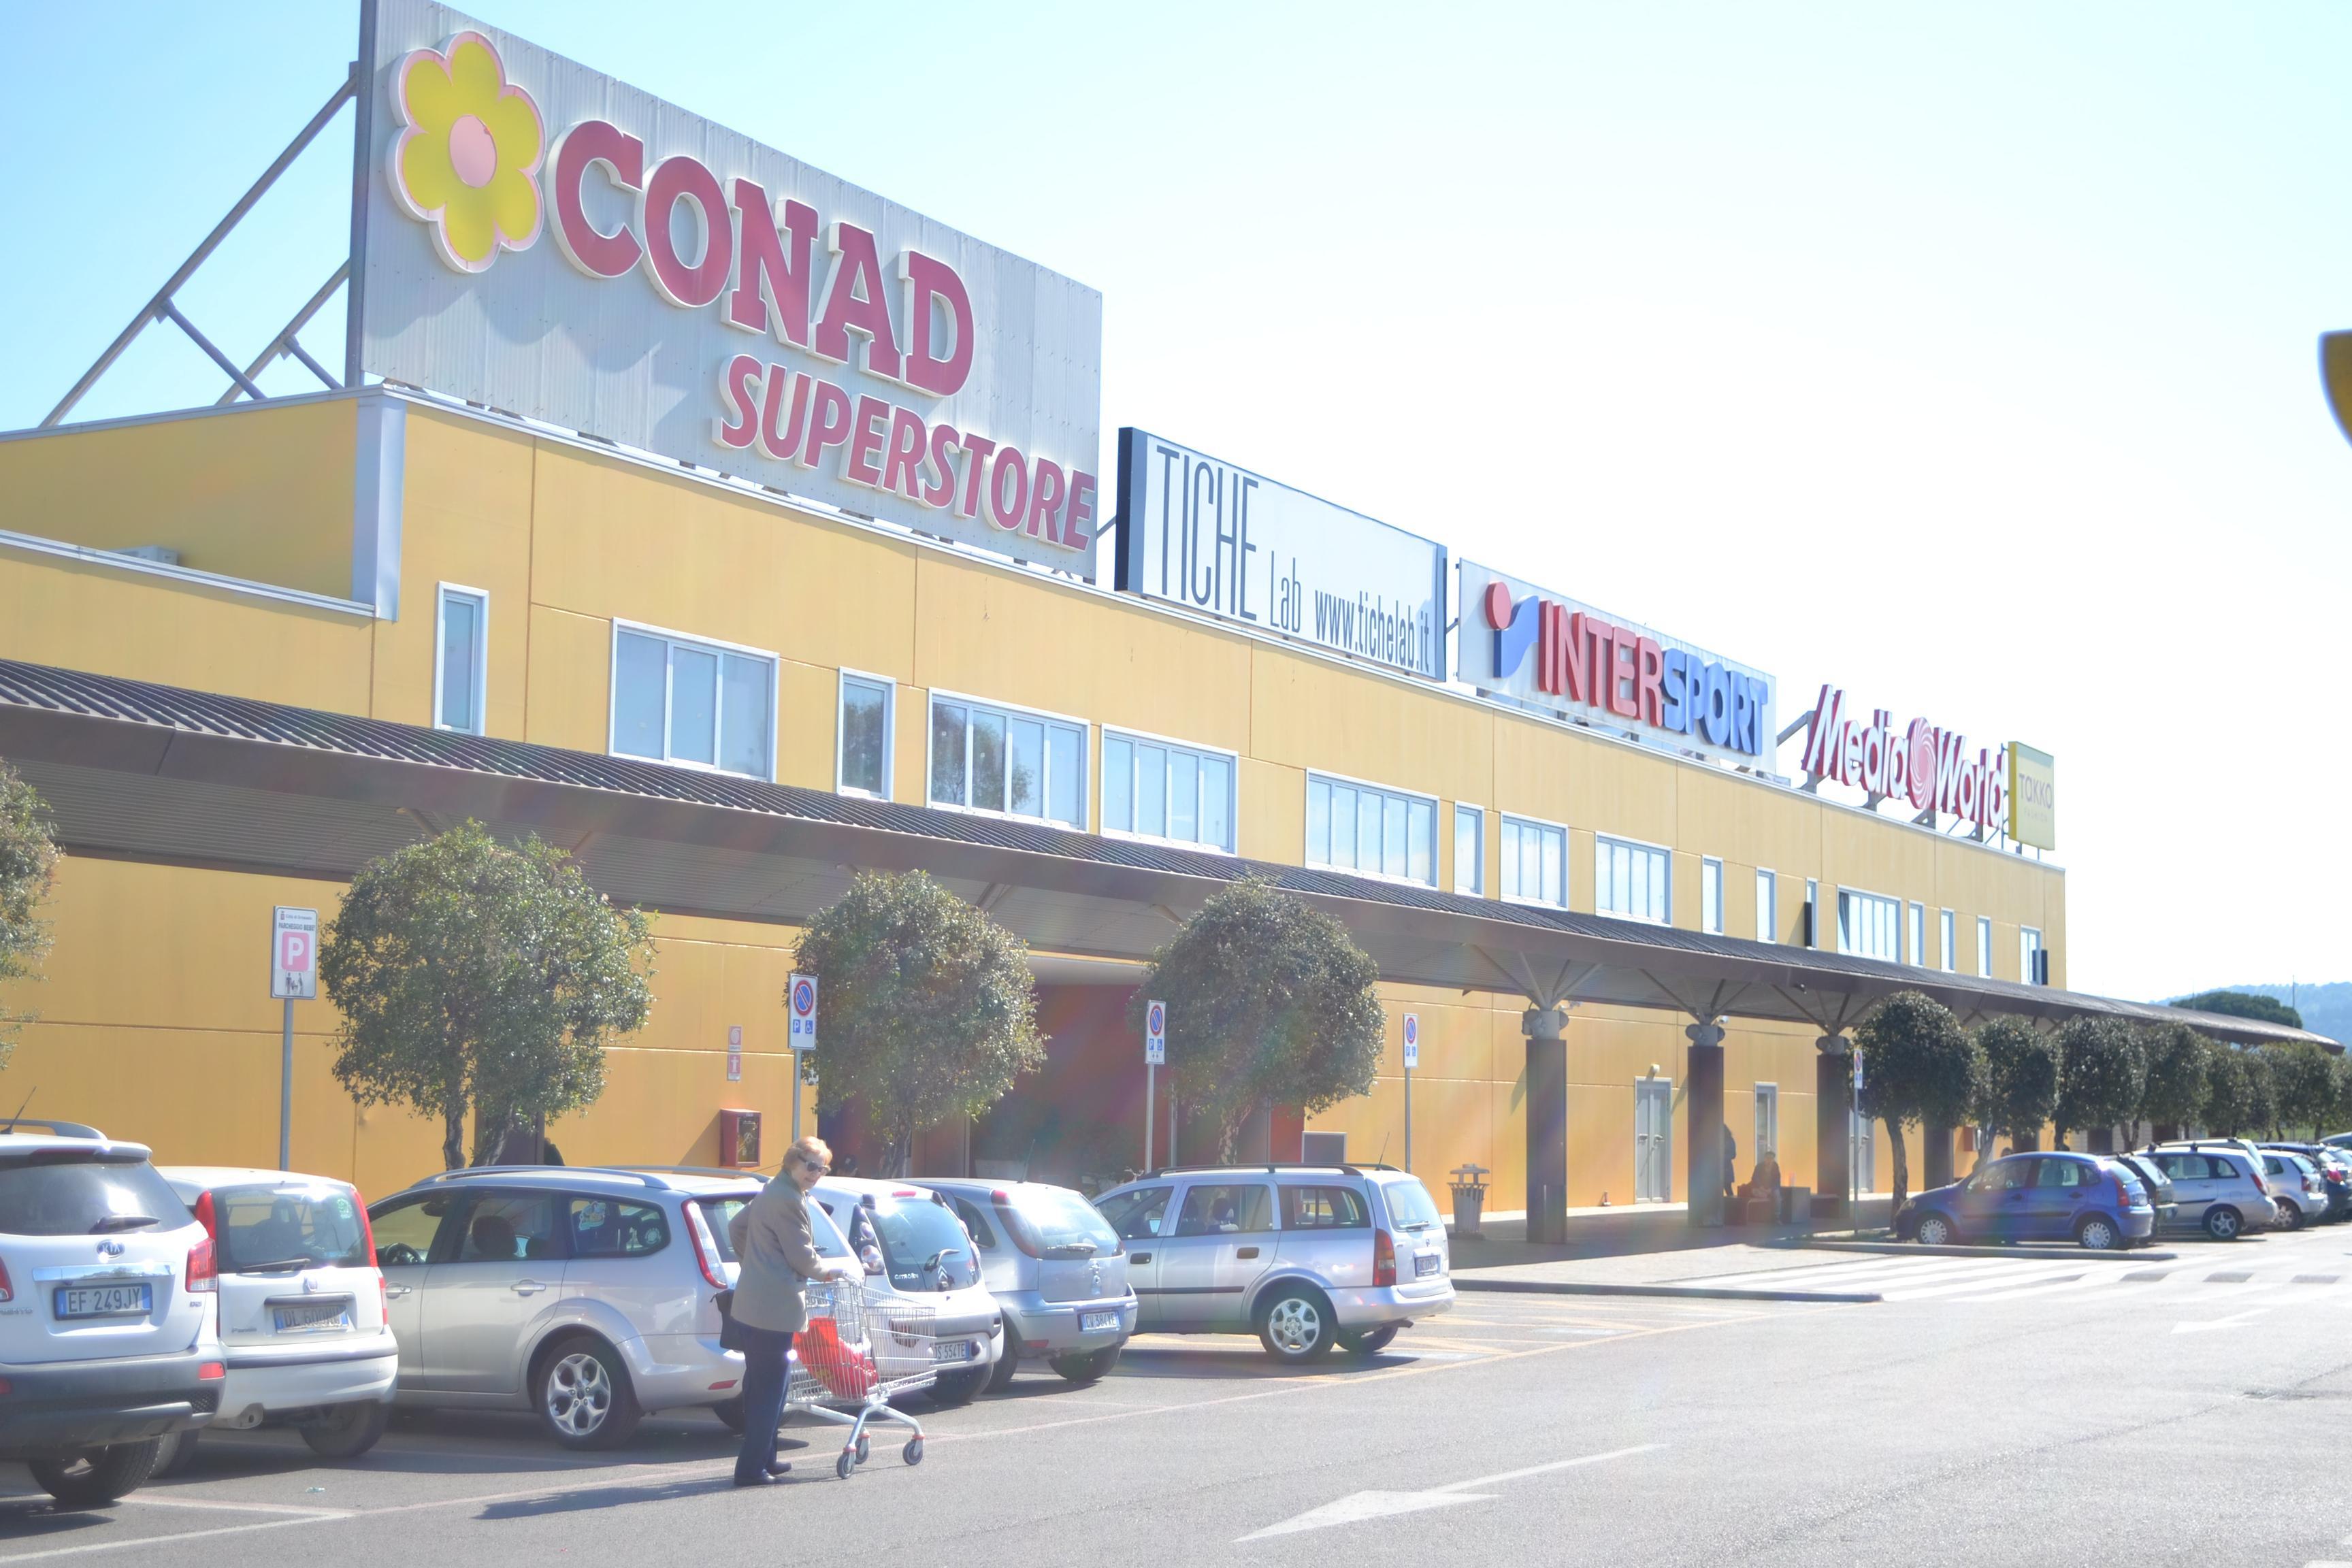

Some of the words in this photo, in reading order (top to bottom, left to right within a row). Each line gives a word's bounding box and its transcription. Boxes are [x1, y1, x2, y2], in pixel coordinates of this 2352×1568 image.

[546, 119, 975, 397] CONAD
[712, 355, 1096, 552] SUPERSTORE
[1156, 444, 1258, 621] TICHE
[1270, 550, 1301, 633] Lab
[1314, 589, 1430, 672] www.tichelab.it
[1538, 599, 1768, 756] INTERSPORT
[288, 936, 304, 965] P
[794, 1020, 800, 1031] P
